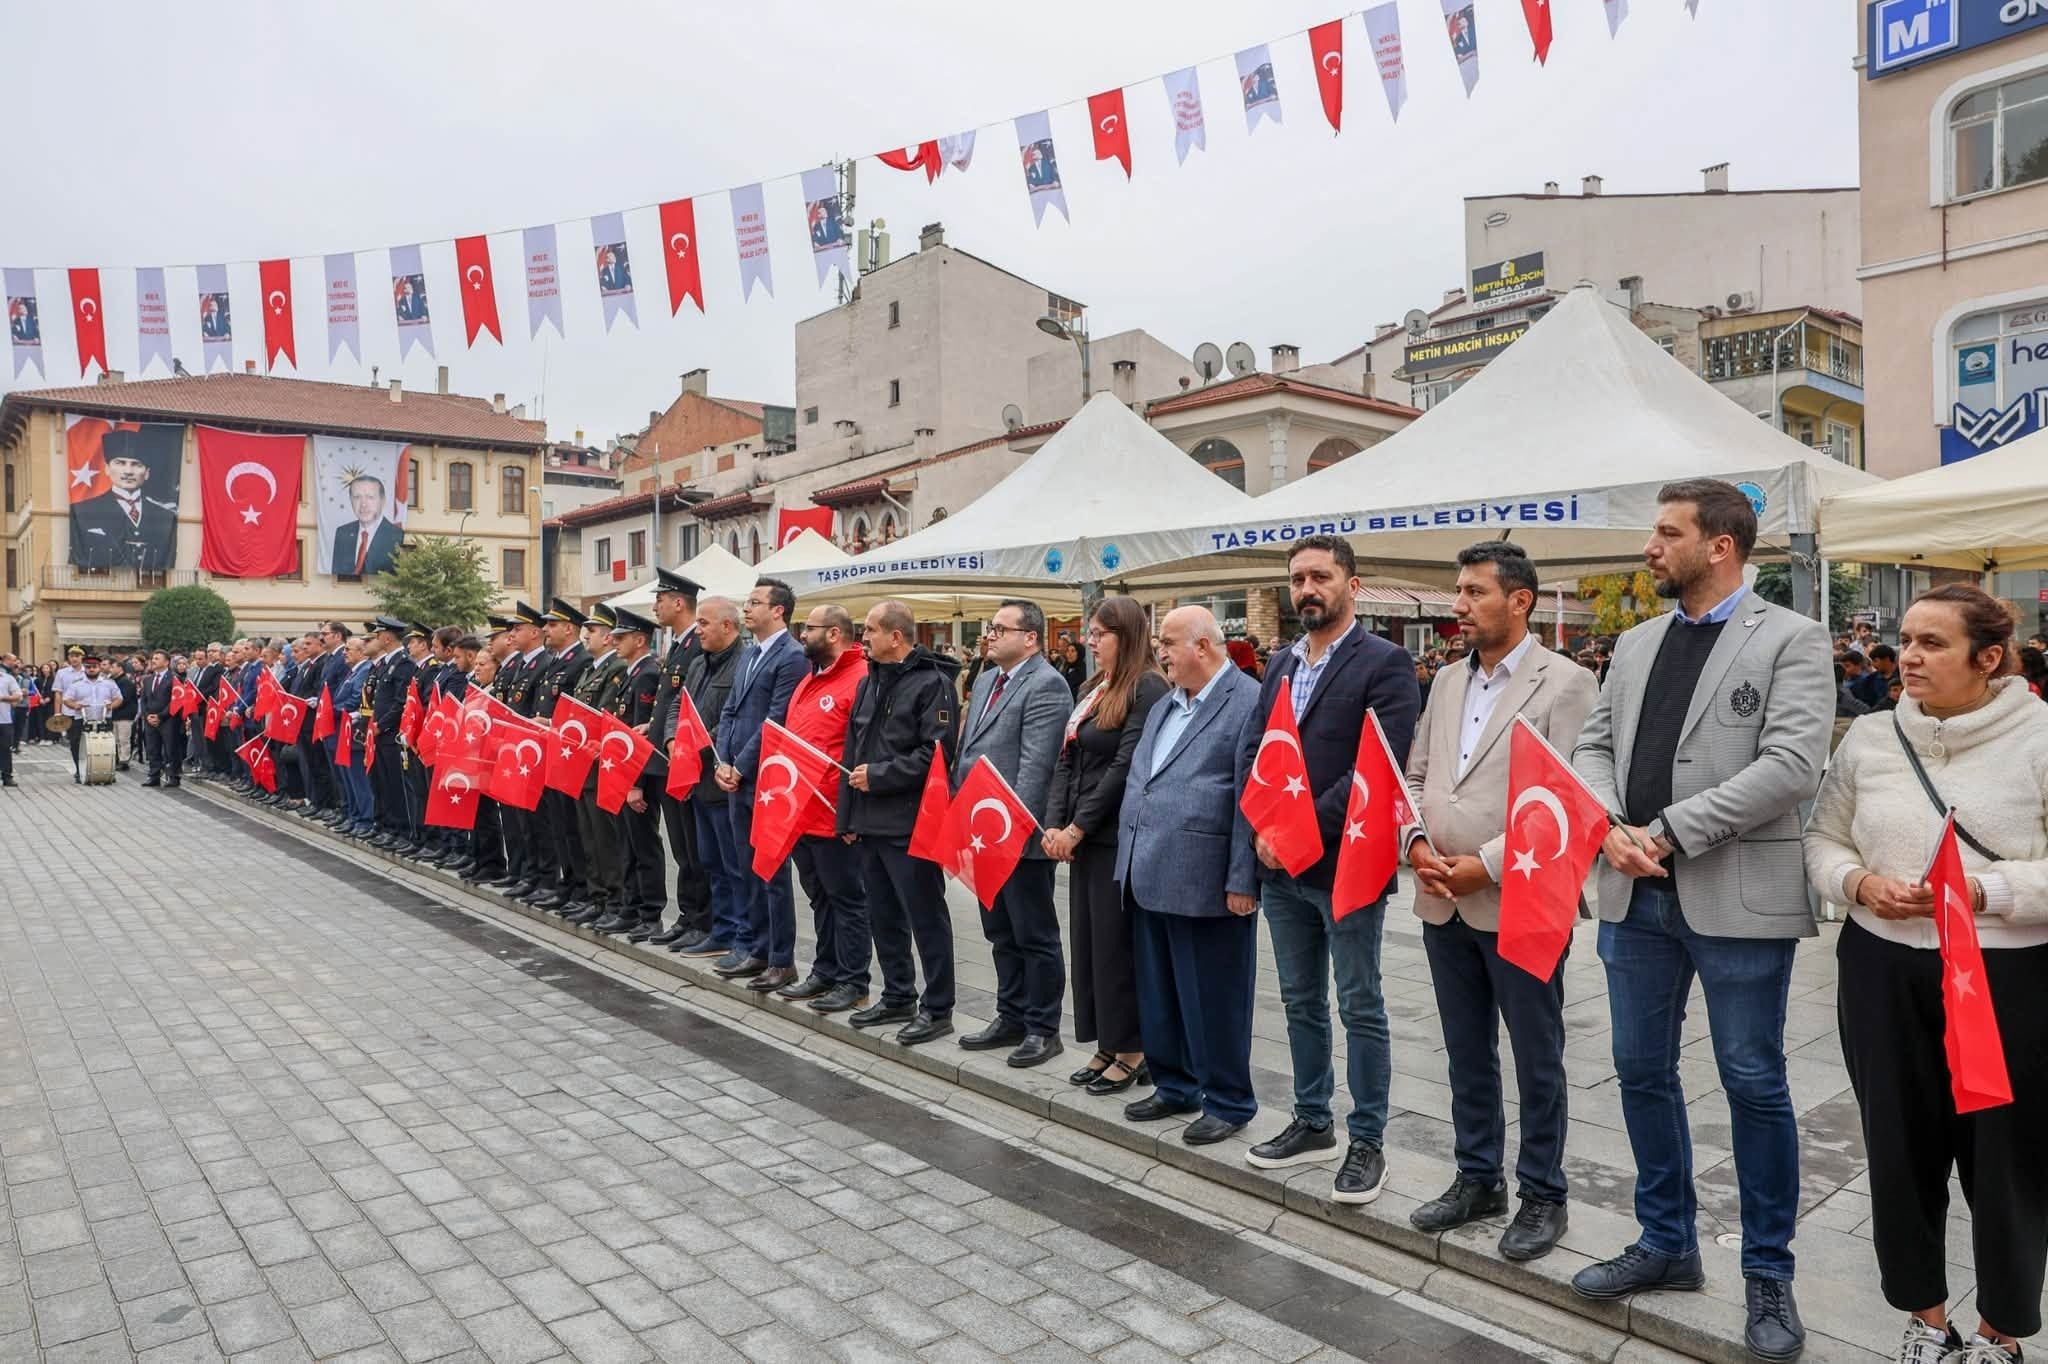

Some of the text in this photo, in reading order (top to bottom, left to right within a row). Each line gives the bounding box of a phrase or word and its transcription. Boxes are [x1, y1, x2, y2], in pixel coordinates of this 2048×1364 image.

[1410, 344, 1441, 362] METİN
[1212, 495, 1577, 550] TAŞKÖPRÜ BELEDİYESİ
[817, 552, 984, 583] TAŞKÖPRÜ BELEDİYESİ
